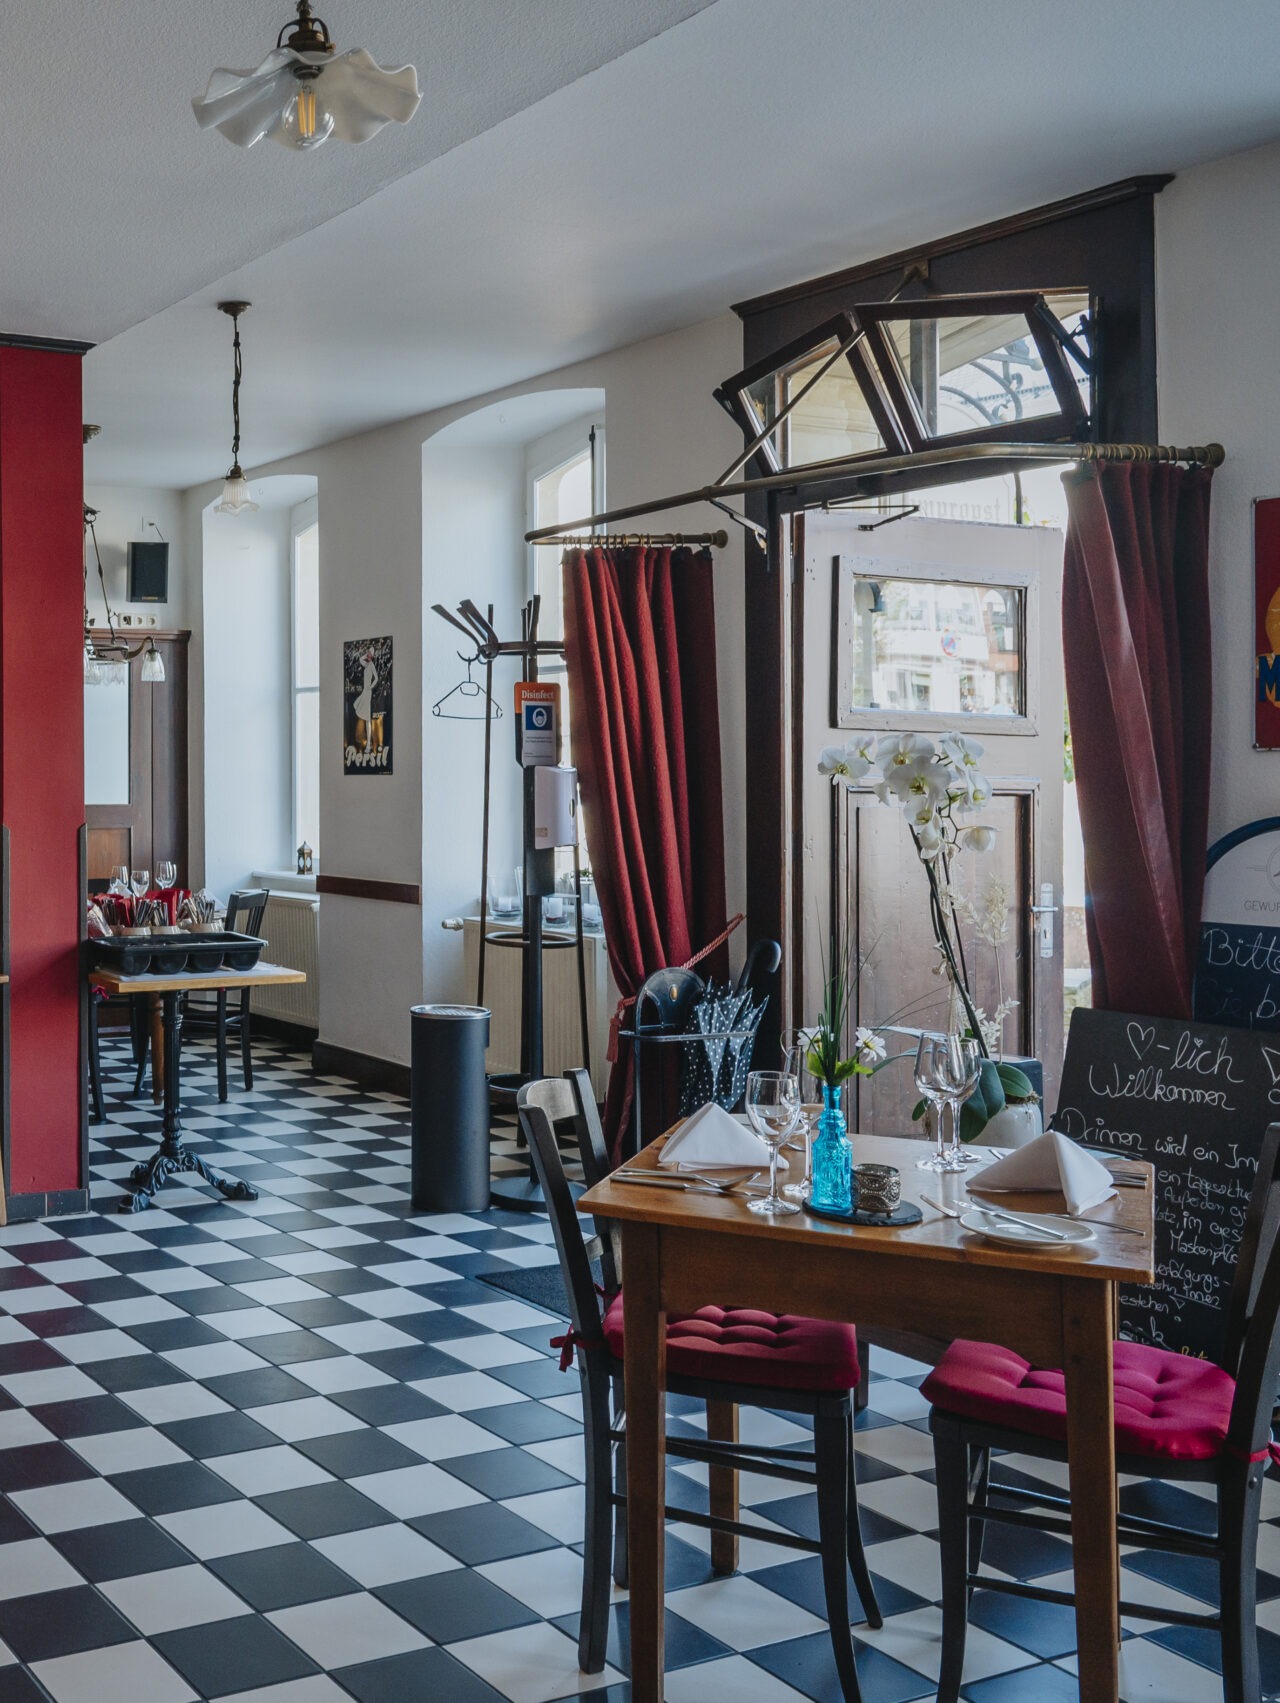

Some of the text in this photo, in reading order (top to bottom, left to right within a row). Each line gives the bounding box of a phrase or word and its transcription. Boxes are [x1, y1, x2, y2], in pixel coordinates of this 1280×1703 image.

[521, 690, 554, 700] Disinfect
[345, 745, 389, 767] Persil
[1089, 1063, 1236, 1111] Willkommen
[1061, 1107, 1148, 1151] Drinnen
[1155, 1134, 1187, 1156] wird
[1193, 1147, 1219, 1163] ein
